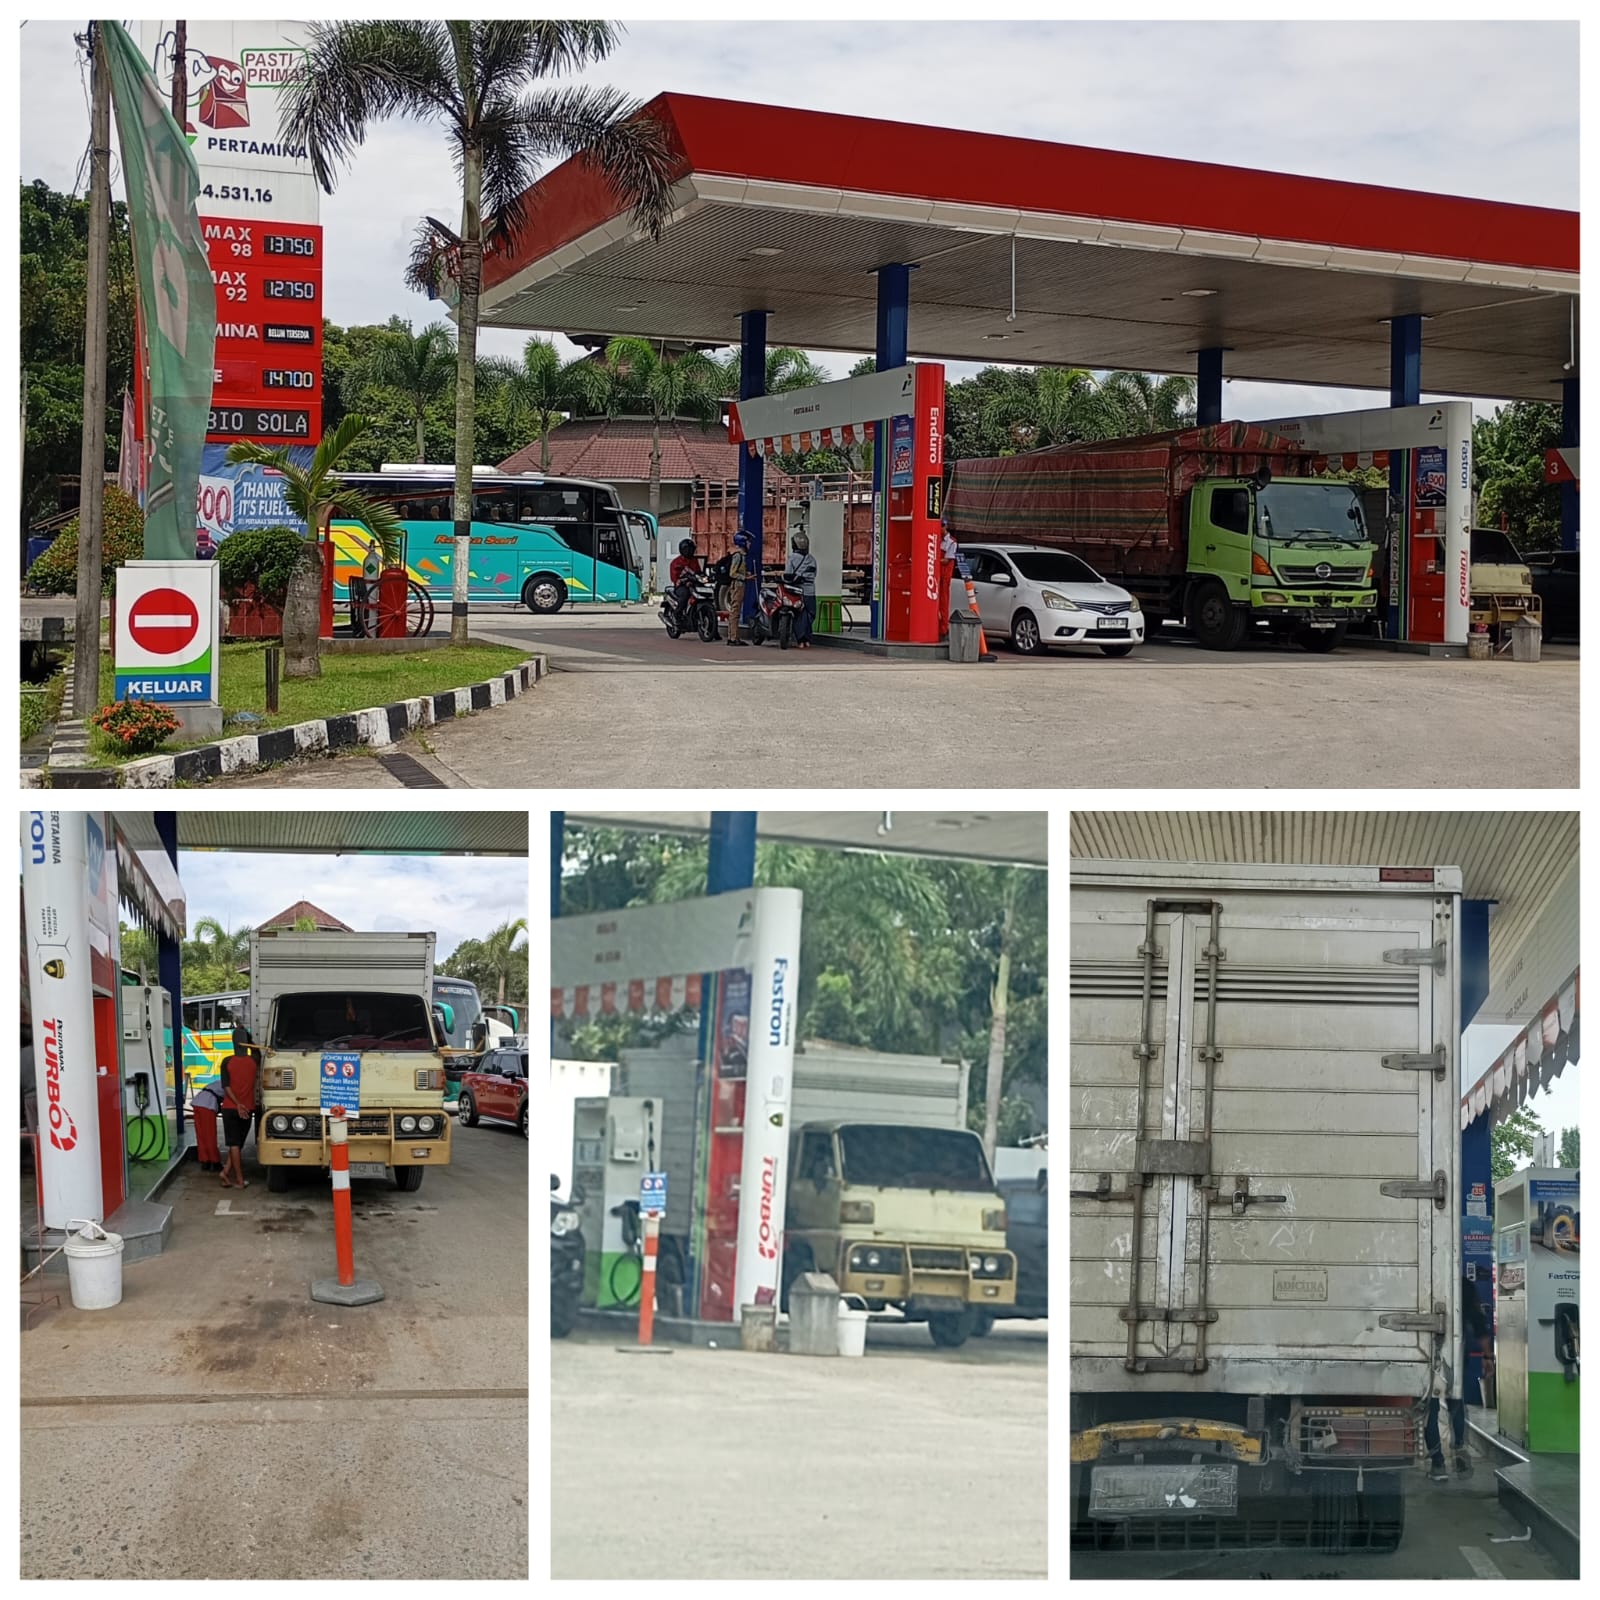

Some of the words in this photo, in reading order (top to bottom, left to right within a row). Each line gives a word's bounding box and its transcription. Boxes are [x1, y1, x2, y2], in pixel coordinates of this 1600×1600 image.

[245, 53, 292, 67] PASTI
[207, 137, 308, 159] PERTAMINA
[230, 243, 253, 257] 98
[269, 237, 314, 256] 13750
[226, 288, 248, 301] 92
[269, 281, 314, 298] 12750
[268, 371, 313, 388] 14700
[257, 413, 308, 433] SOLA
[930, 407, 939, 464] Enduro
[1461, 439, 1470, 489] Fastron
[1550, 462, 1559, 475] 3
[242, 481, 281, 498] THANK
[259, 500, 284, 516] FUEL
[128, 681, 202, 694] KELUAR
[769, 957, 788, 1046] Fastron
[56, 1019, 64, 1072] PERTAMAX
[42, 1018, 63, 1130] TURBO
[760, 1156, 774, 1241] TURBO
